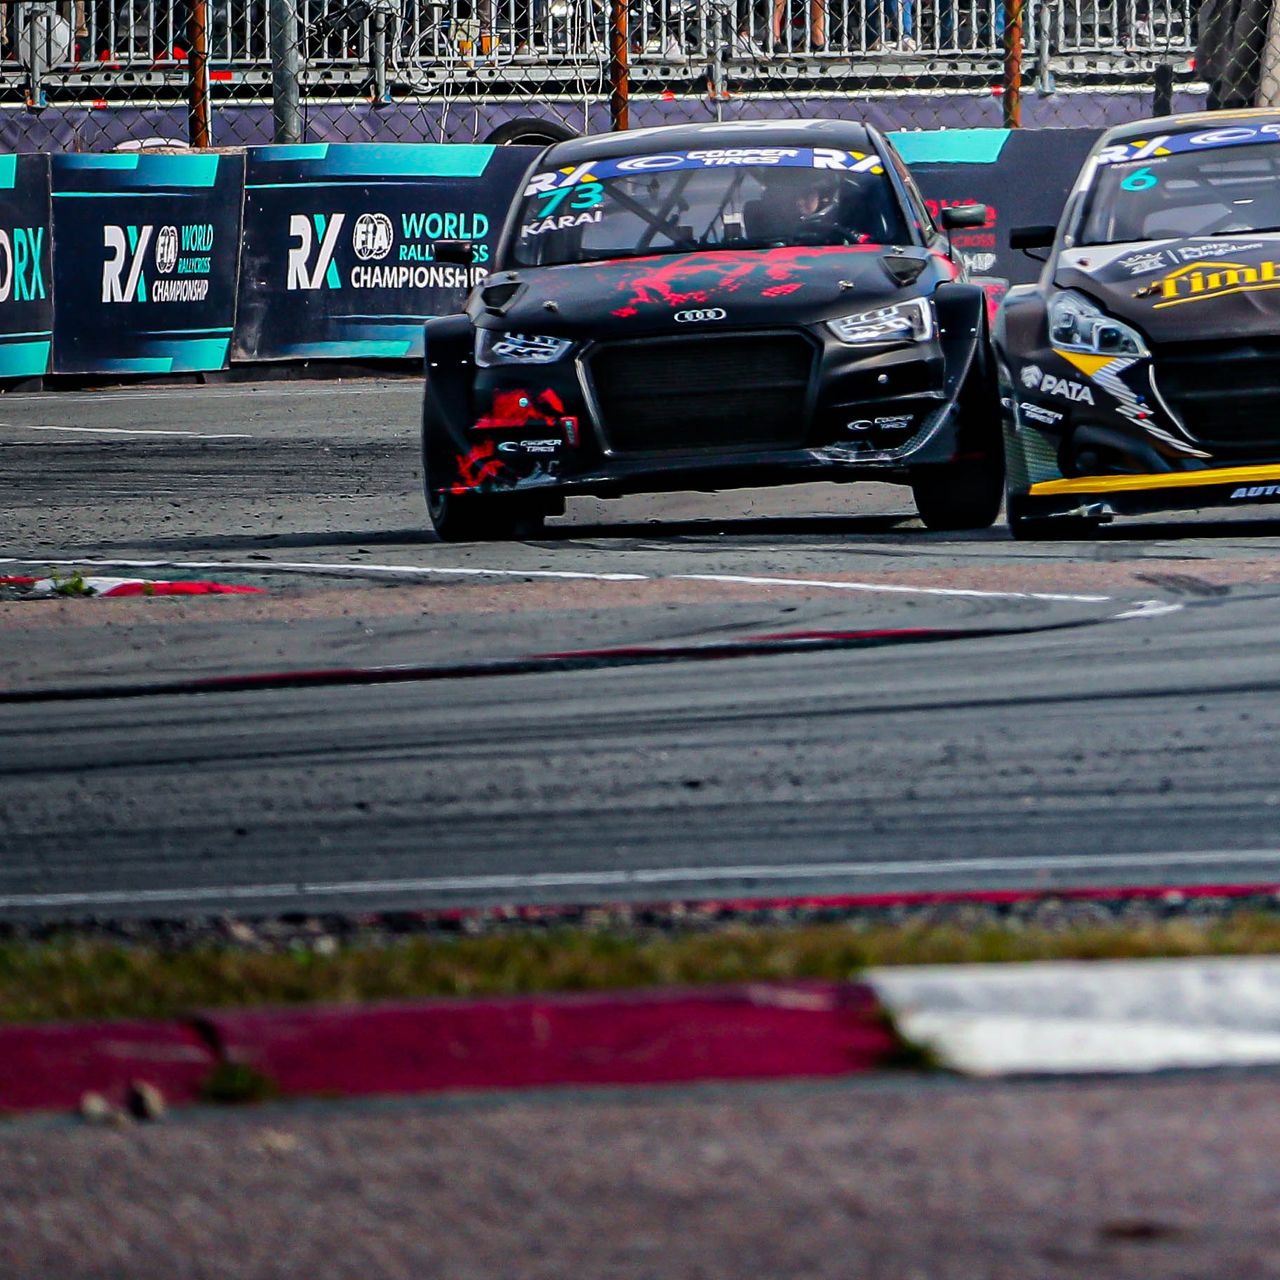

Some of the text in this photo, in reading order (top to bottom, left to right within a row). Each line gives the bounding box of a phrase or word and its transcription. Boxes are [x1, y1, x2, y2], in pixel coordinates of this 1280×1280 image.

[686, 148, 798, 159] COOPER
[701, 155, 779, 166] TIRES
[813, 149, 885, 175] RX
[1097, 135, 1171, 165] RX
[523, 161, 599, 196] RX
[1120, 167, 1158, 191] 6
[537, 182, 604, 218] 73
[182, 224, 214, 252] WORLD
[355, 223, 390, 250] FIA
[402, 212, 490, 239] WORLD
[156, 235, 178, 263] FIA
[286, 213, 346, 290] RX
[102, 225, 154, 303] RX
[152, 279, 209, 303] CHAMPIONSHIP
[1040, 373, 1096, 406] PATA
